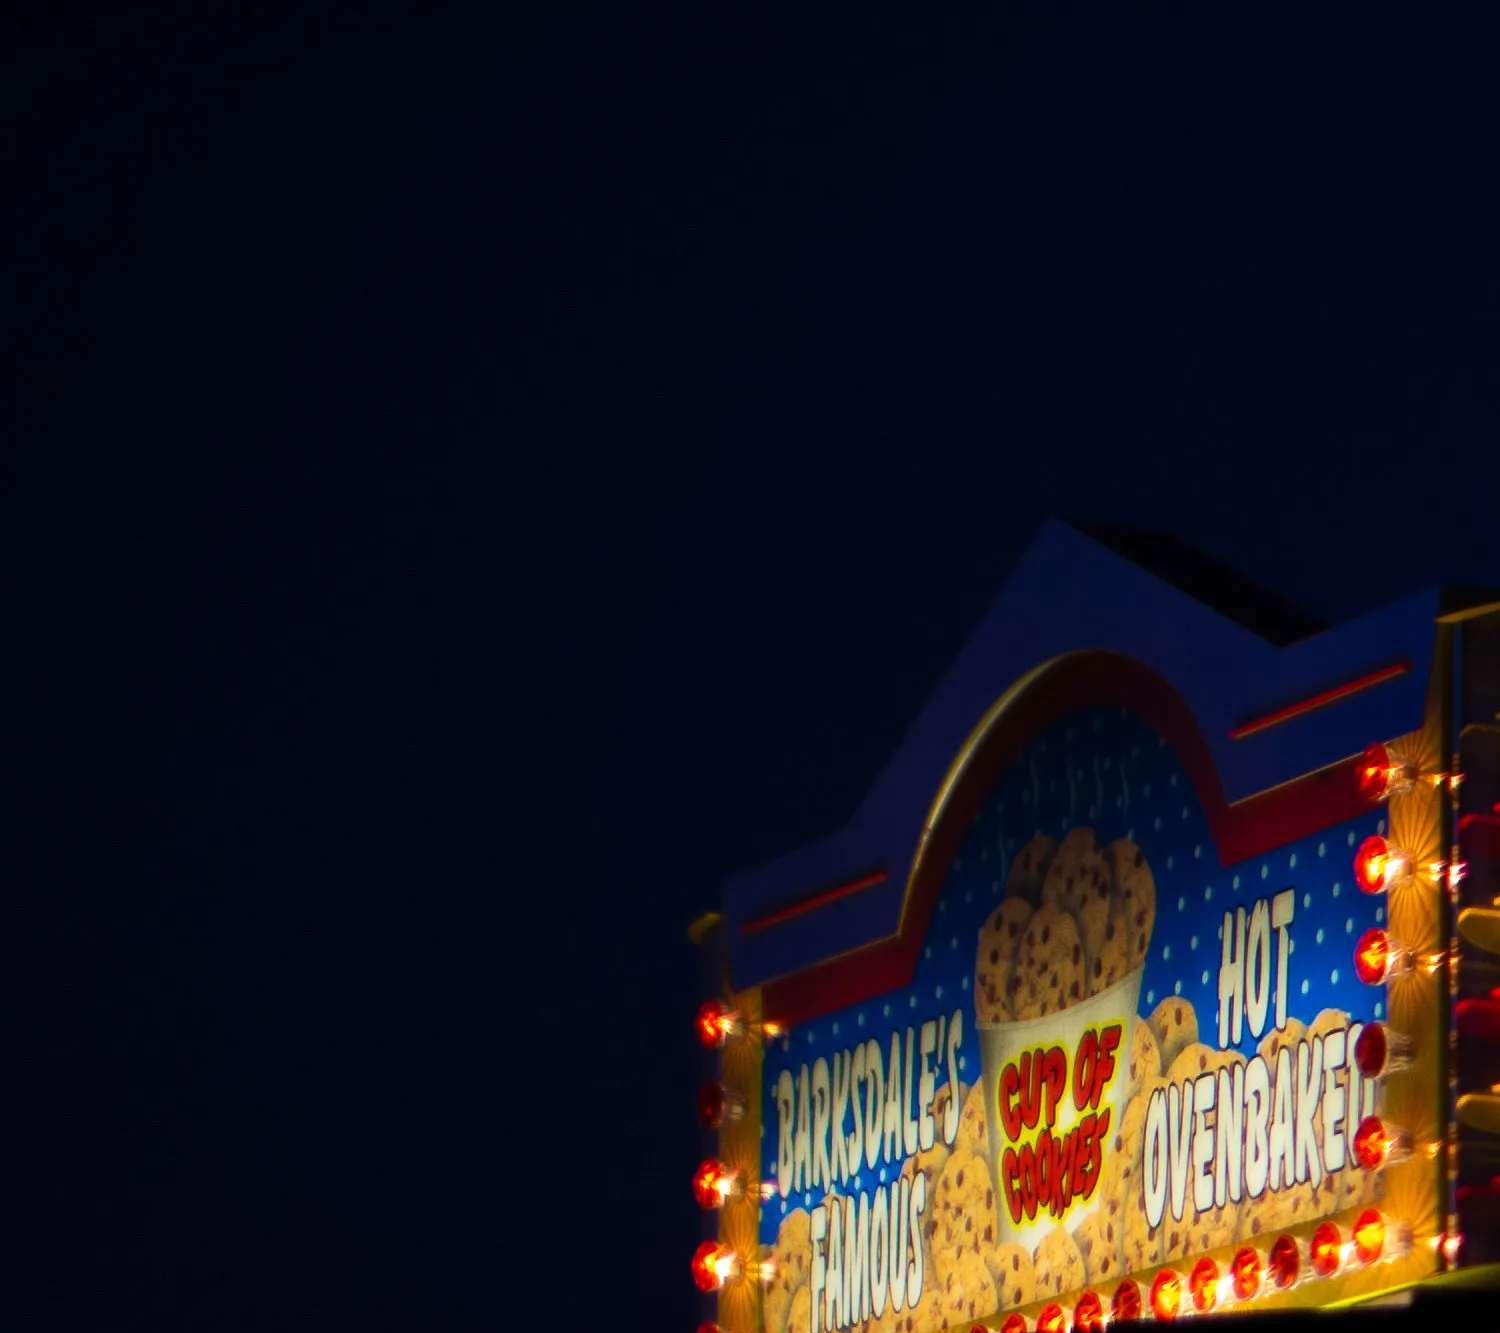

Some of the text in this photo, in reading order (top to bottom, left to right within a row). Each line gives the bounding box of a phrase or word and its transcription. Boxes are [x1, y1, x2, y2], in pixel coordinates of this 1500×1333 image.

[1216, 887, 1295, 1050] HOT
[775, 1007, 963, 1199] BARKSDALE'S
[999, 1022, 1123, 1144] CUP OF
[1002, 1108, 1110, 1226] COOKIES
